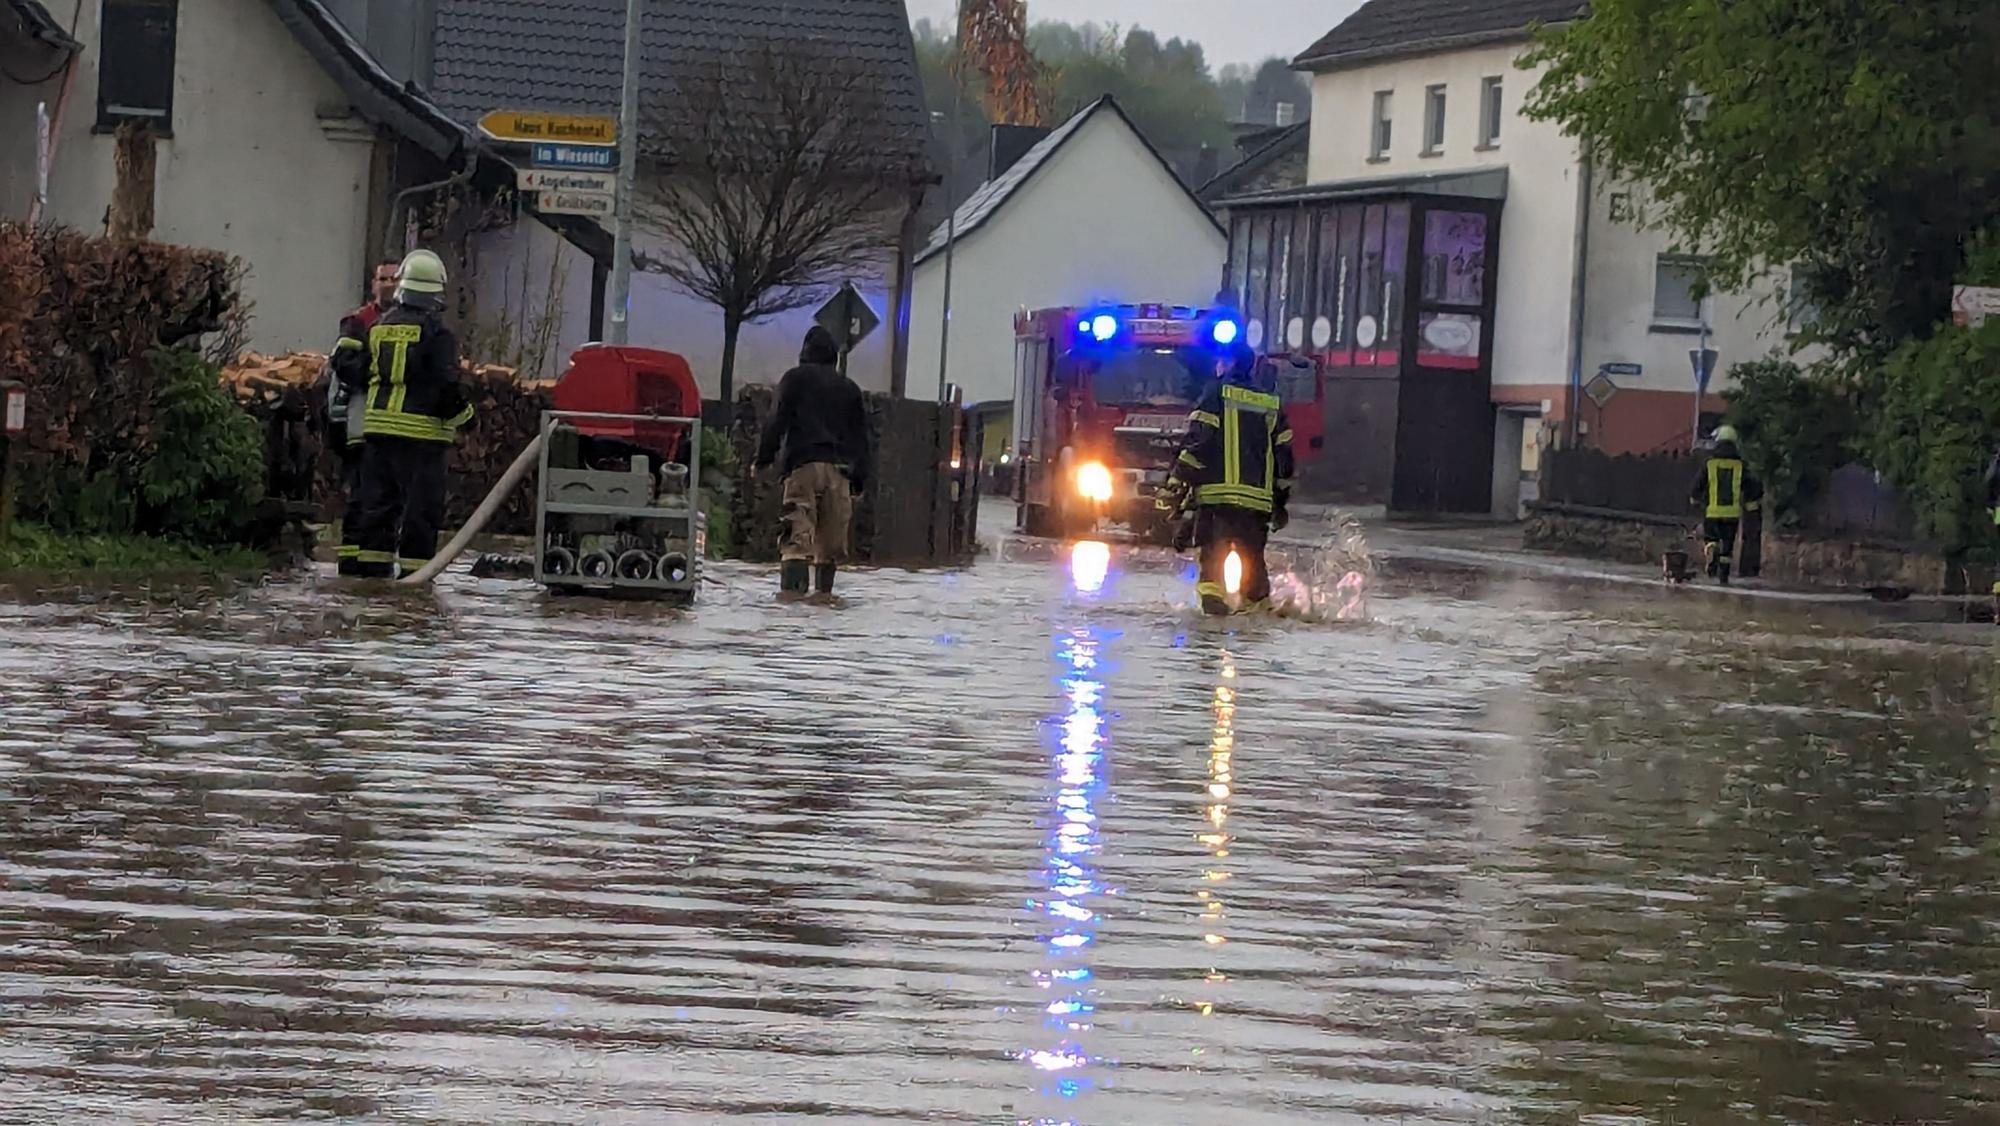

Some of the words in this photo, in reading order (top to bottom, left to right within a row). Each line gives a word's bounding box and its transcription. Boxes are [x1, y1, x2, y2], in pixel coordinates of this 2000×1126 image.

[513, 118, 541, 133] Haus
[538, 147, 552, 160] Im
[556, 148, 610, 164] Wiesental
[539, 175, 605, 191] Angelweiher
